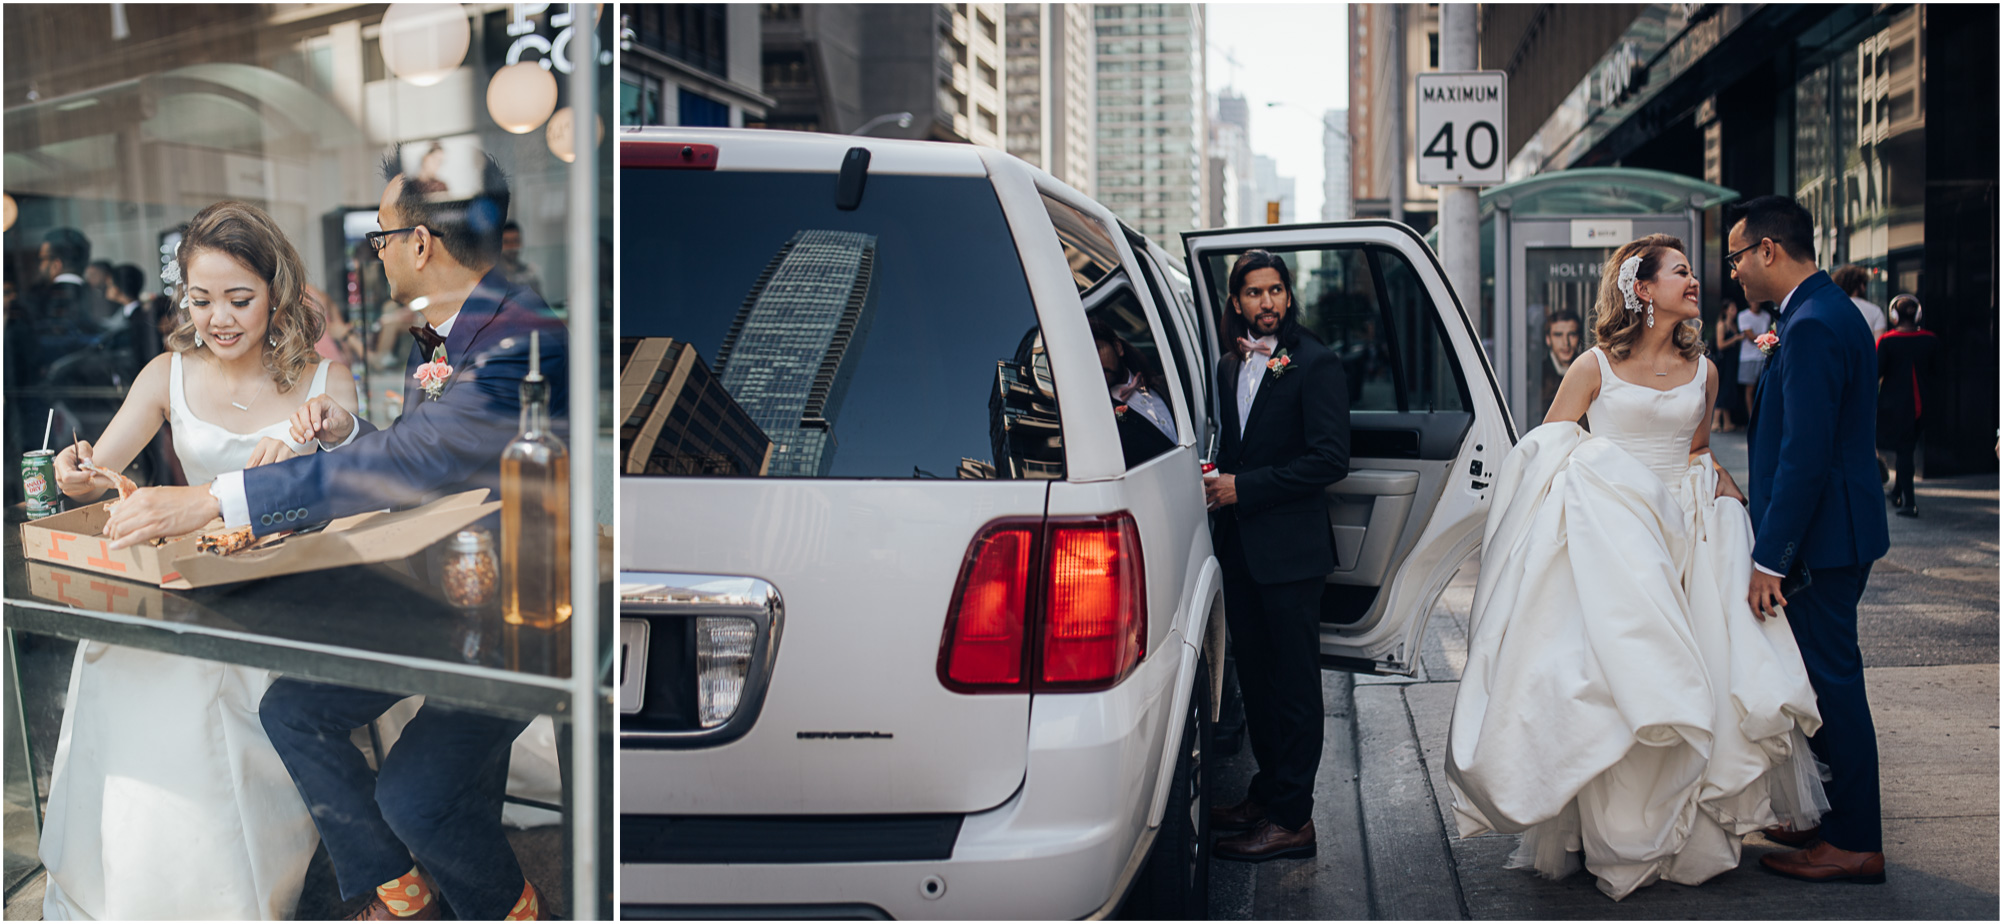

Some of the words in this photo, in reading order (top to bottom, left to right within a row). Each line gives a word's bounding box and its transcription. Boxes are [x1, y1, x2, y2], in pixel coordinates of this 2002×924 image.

[1423, 86, 1499, 103] MAXIMUM
[1422, 120, 1499, 171] 40
[1550, 262, 1584, 277] HOLT
